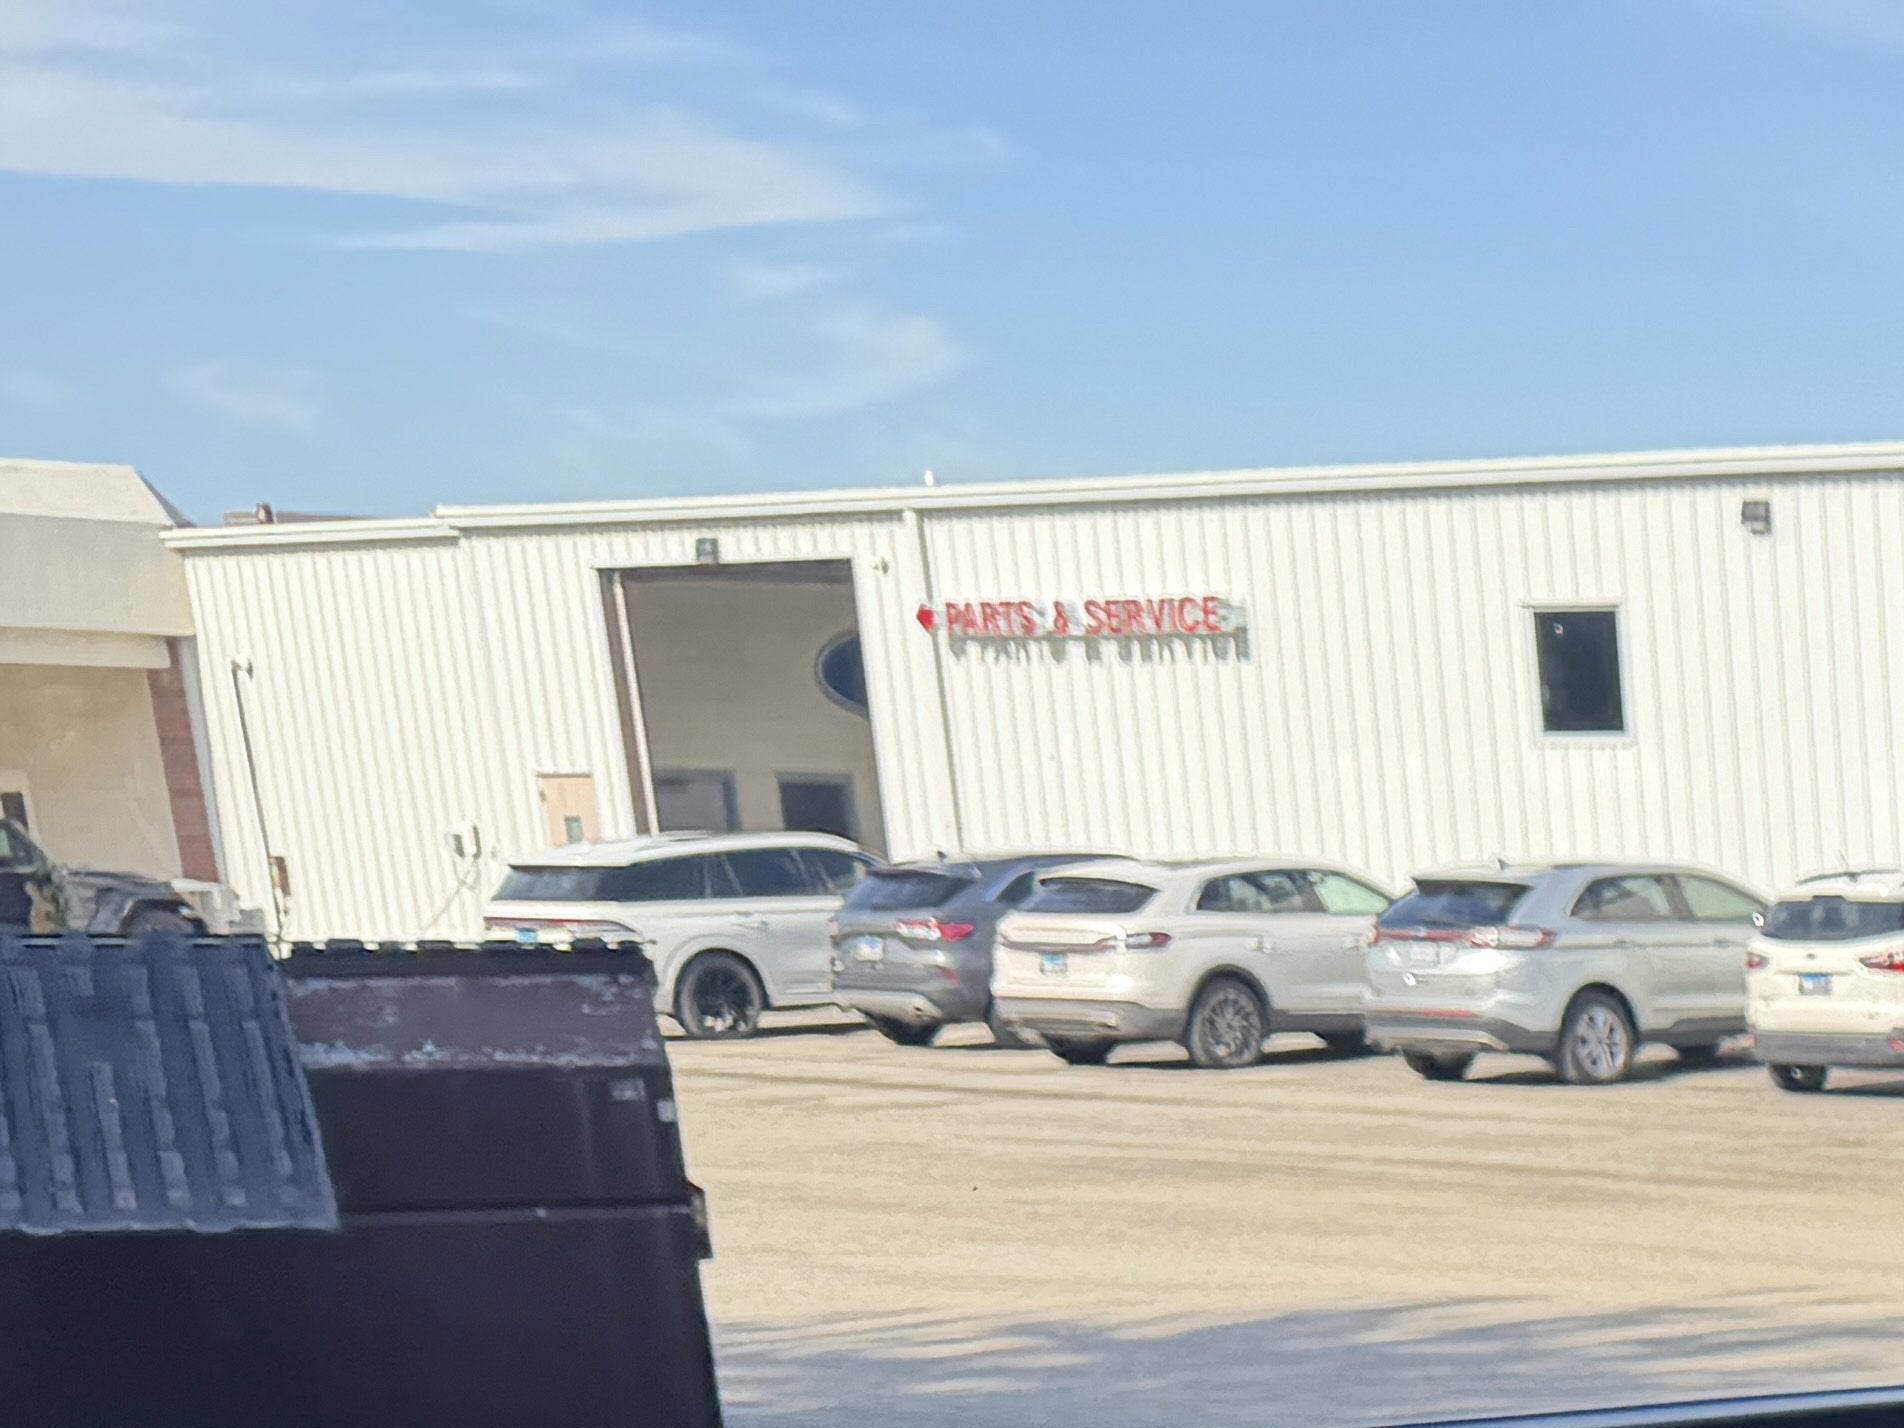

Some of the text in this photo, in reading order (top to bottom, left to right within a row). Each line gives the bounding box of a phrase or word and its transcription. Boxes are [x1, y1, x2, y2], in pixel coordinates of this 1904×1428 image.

[945, 596, 1224, 635] PARTS & SERVICE
